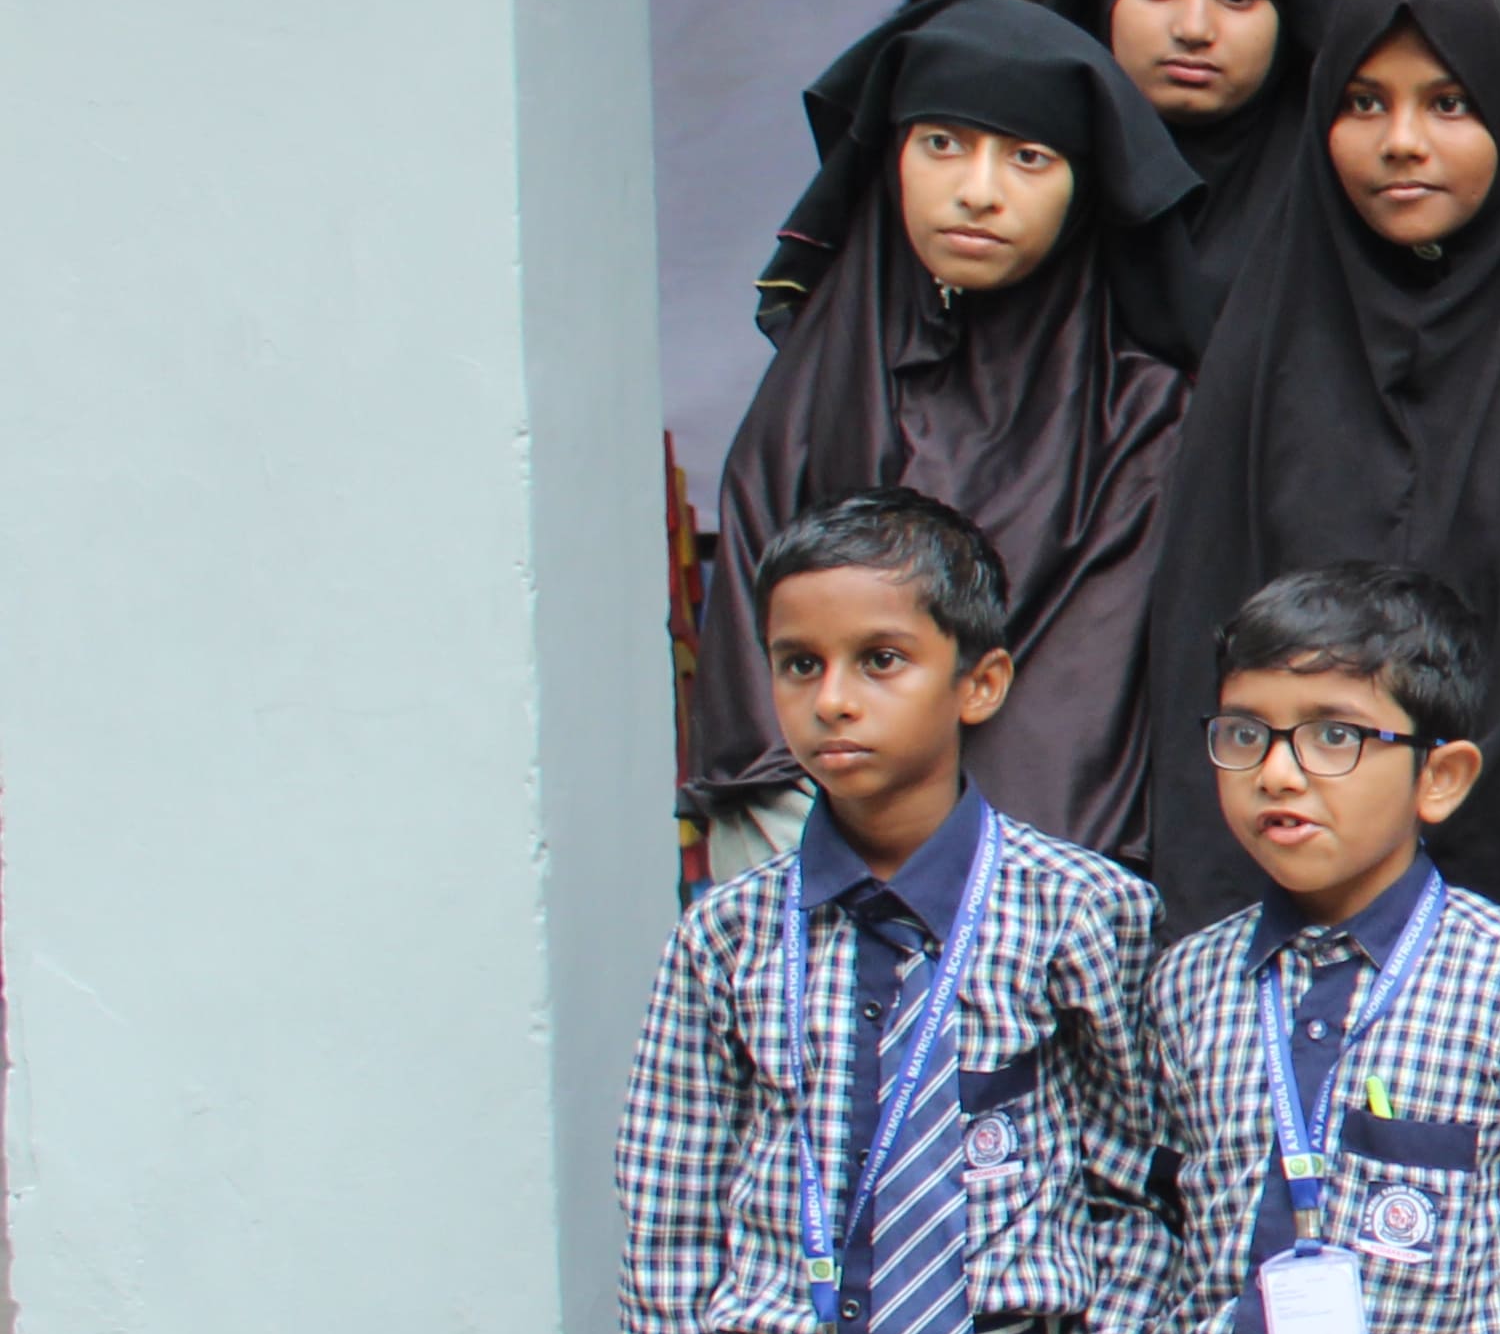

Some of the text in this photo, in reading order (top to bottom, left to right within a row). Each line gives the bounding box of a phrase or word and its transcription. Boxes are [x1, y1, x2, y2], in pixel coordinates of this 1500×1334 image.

[1390, 893, 1437, 977] MATRICULATION
[1261, 978, 1281, 1043] MEMORIAL
[864, 1149, 890, 1192] RAHIM
[879, 1079, 917, 1151] MEMORIAL
[907, 973, 957, 1081] MATRICULATION
[951, 921, 974, 977] SCHOOL
[1269, 1042, 1287, 1086] RAHIM
[1275, 1086, 1294, 1128] ABDUL
[806, 1182, 825, 1227] ABDUL
